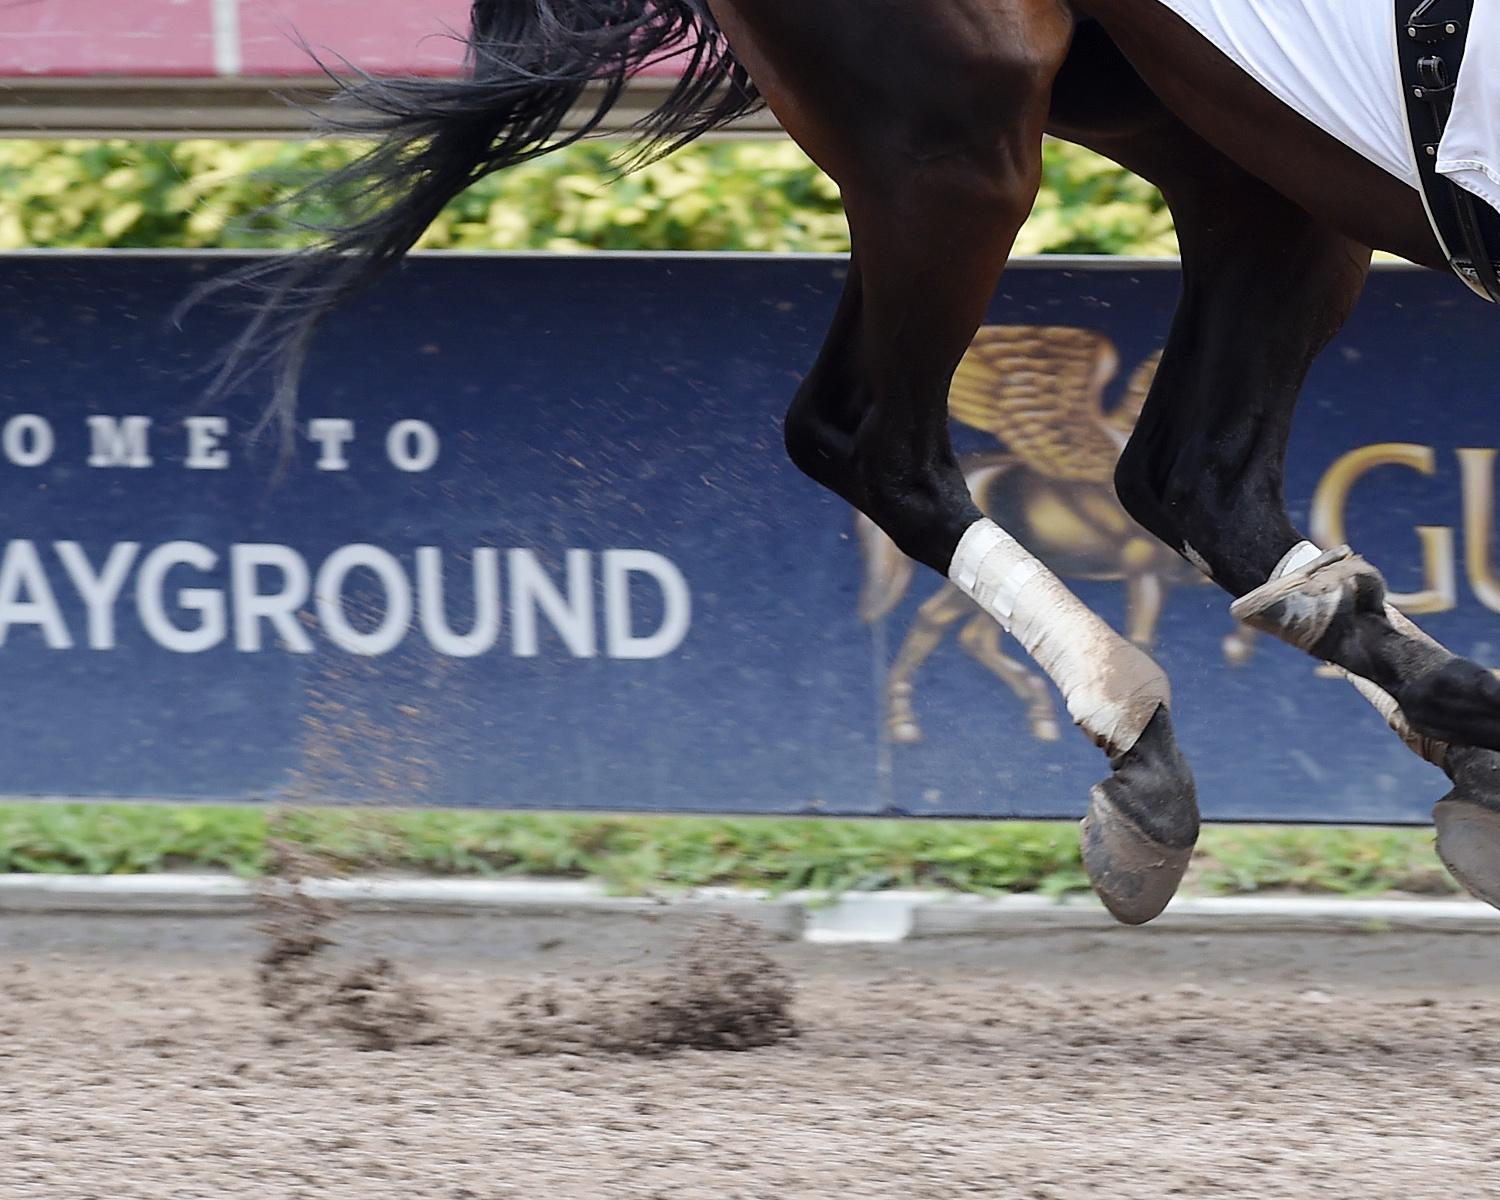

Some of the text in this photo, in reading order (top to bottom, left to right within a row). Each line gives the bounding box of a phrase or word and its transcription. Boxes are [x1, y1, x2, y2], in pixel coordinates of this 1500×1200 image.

[2, 413, 441, 473] OME TO
[0, 539, 693, 660] AYGROUND
